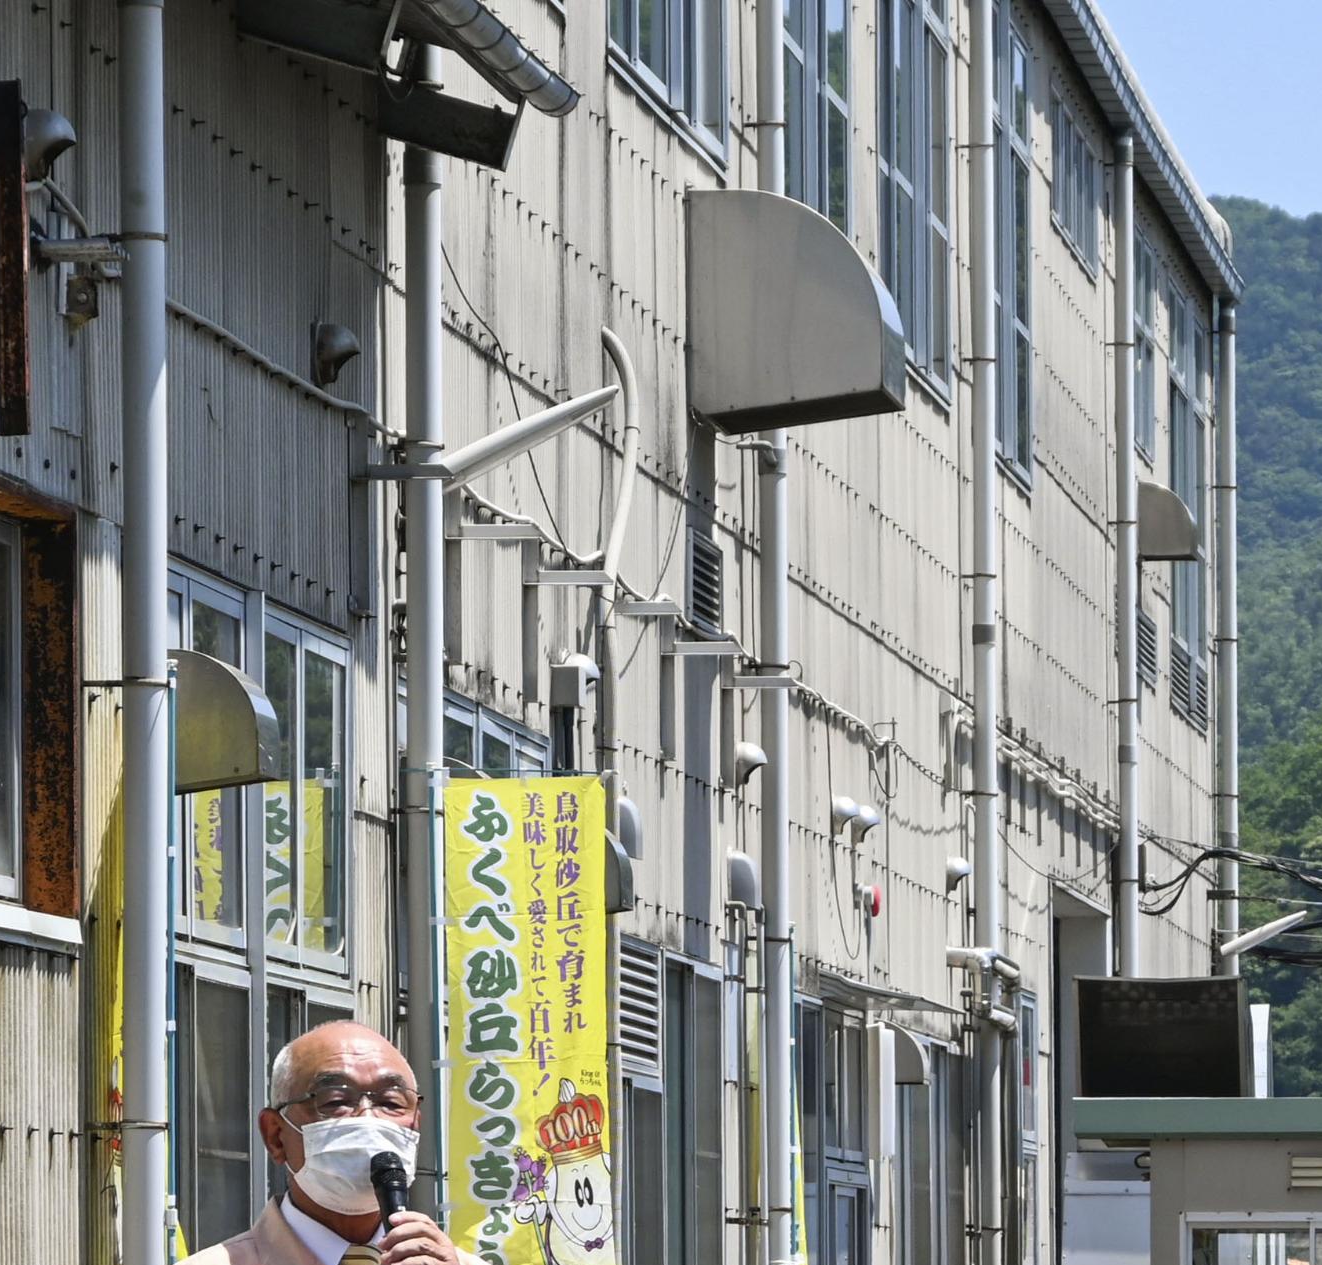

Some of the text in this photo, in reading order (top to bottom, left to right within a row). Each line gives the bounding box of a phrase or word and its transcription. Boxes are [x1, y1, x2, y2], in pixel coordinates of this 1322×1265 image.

[553, 791, 588, 1034] 鳥取砂丘で育まれ
[541, 1105, 602, 1148] 100th
